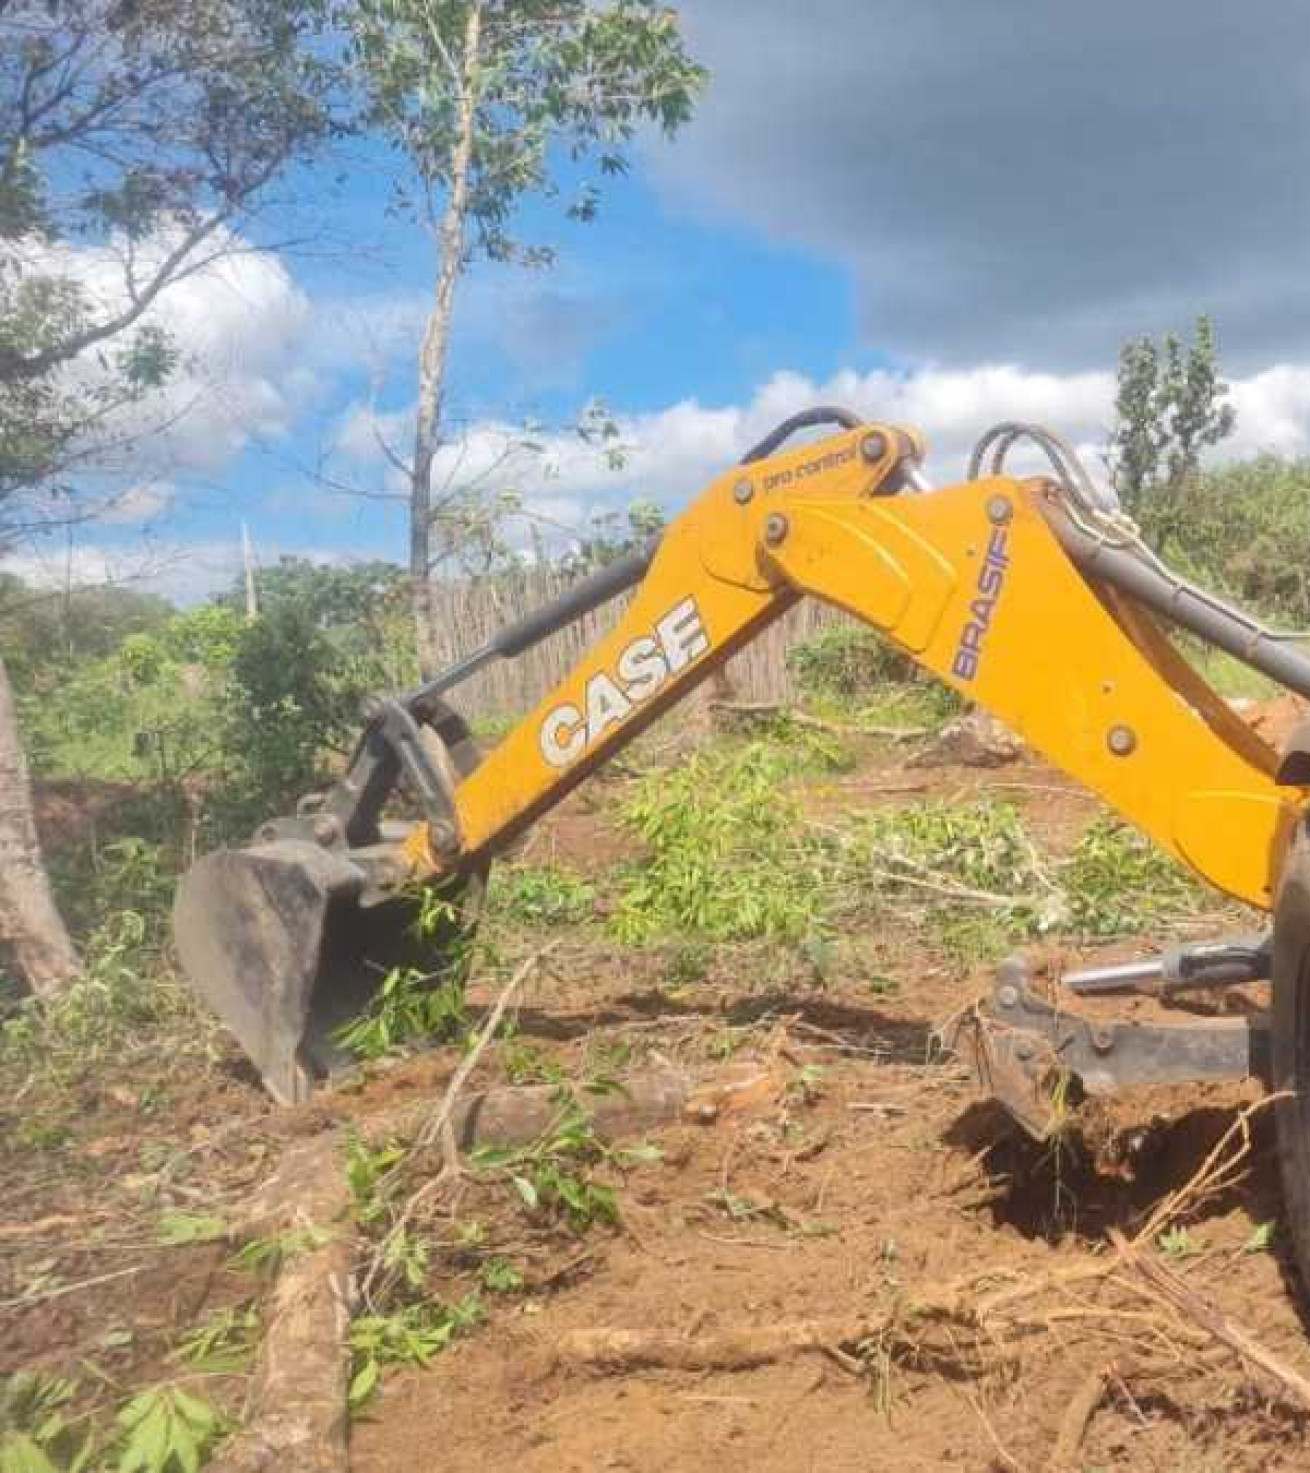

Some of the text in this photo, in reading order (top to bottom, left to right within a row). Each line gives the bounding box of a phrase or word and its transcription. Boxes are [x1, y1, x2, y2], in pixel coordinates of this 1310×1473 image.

[764, 444, 858, 494] pro control
[541, 595, 711, 766] CASE
[953, 524, 1010, 681] BRASIF
